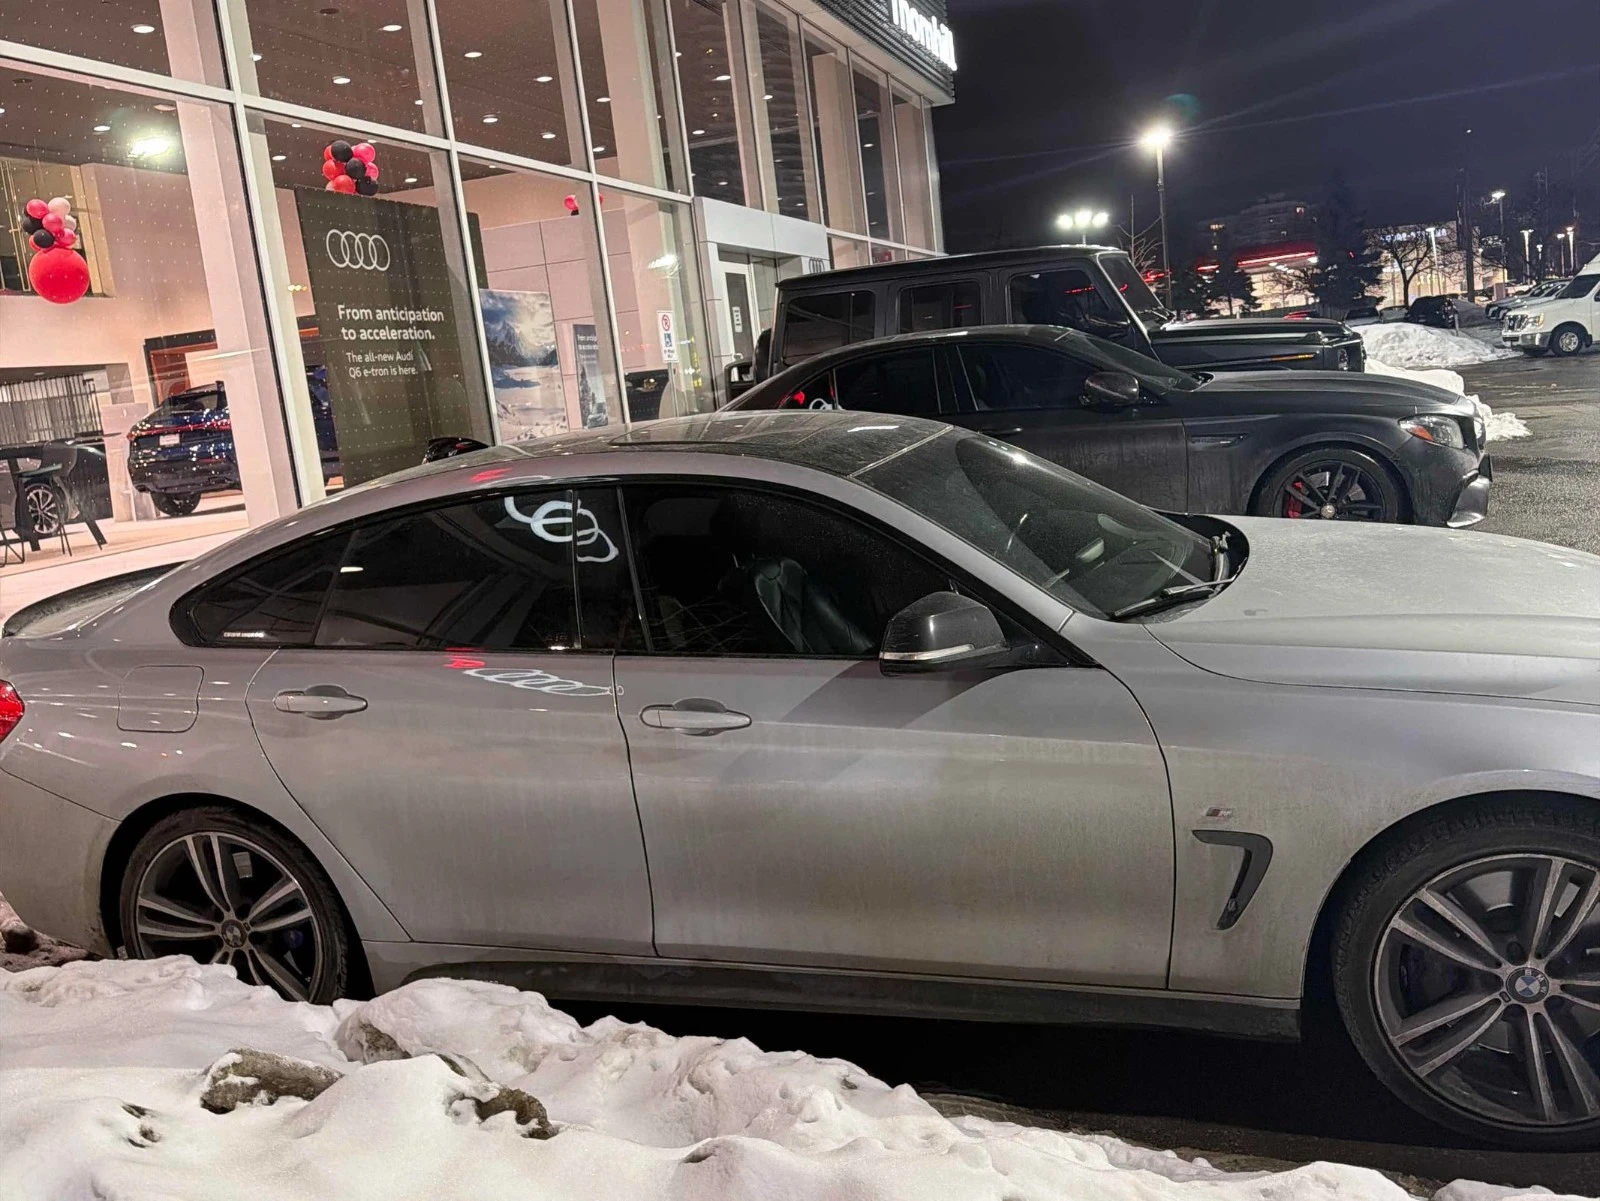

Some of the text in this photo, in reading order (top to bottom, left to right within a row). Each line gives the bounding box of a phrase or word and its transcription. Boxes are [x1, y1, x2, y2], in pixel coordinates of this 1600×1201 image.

[337, 304, 445, 324] From anticipation
[341, 325, 435, 340] to acceleration.
[346, 349, 414, 363] The all-new Audi
[348, 365, 419, 379] Q6 e-tron is here.
